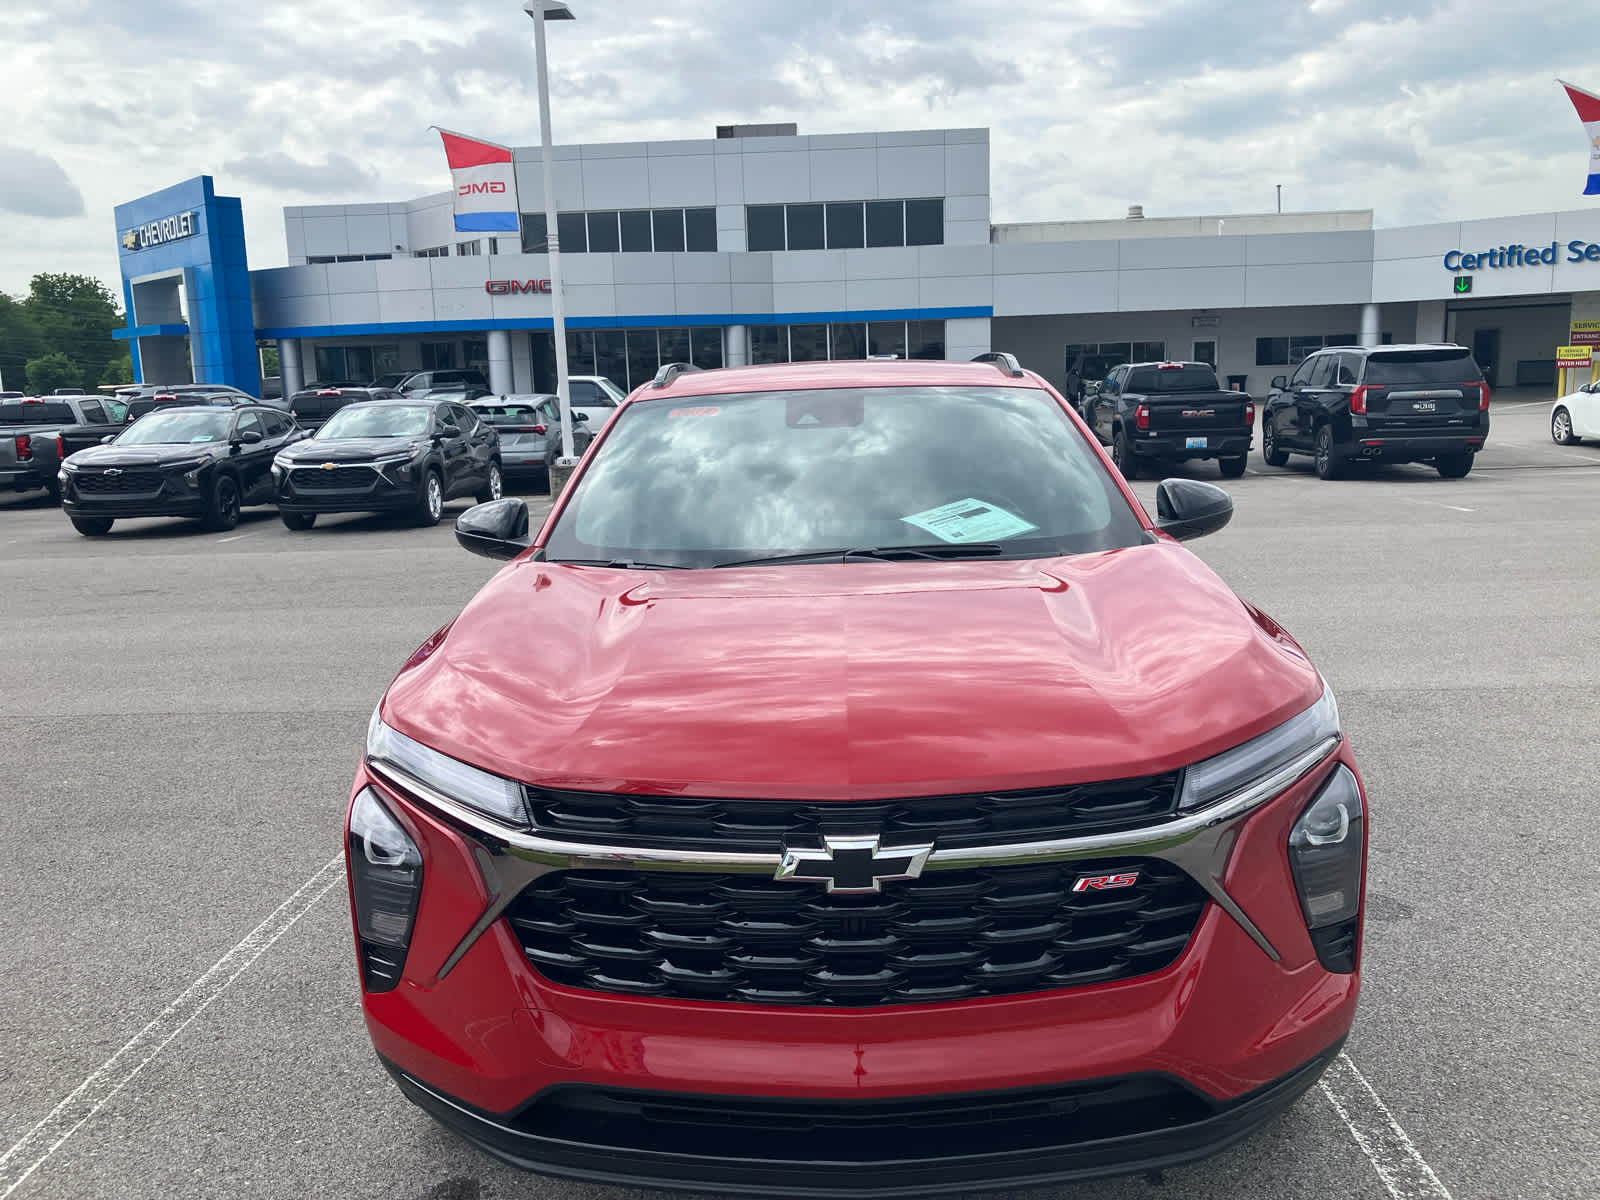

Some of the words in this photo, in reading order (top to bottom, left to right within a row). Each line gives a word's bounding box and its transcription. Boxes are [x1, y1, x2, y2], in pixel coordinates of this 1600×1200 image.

[140, 211, 195, 247] CHEVROLET
[1444, 241, 1557, 271] Certified
[486, 279, 552, 294] GMC
[1182, 409, 1216, 417] GMC
[1072, 871, 1140, 891] RS
